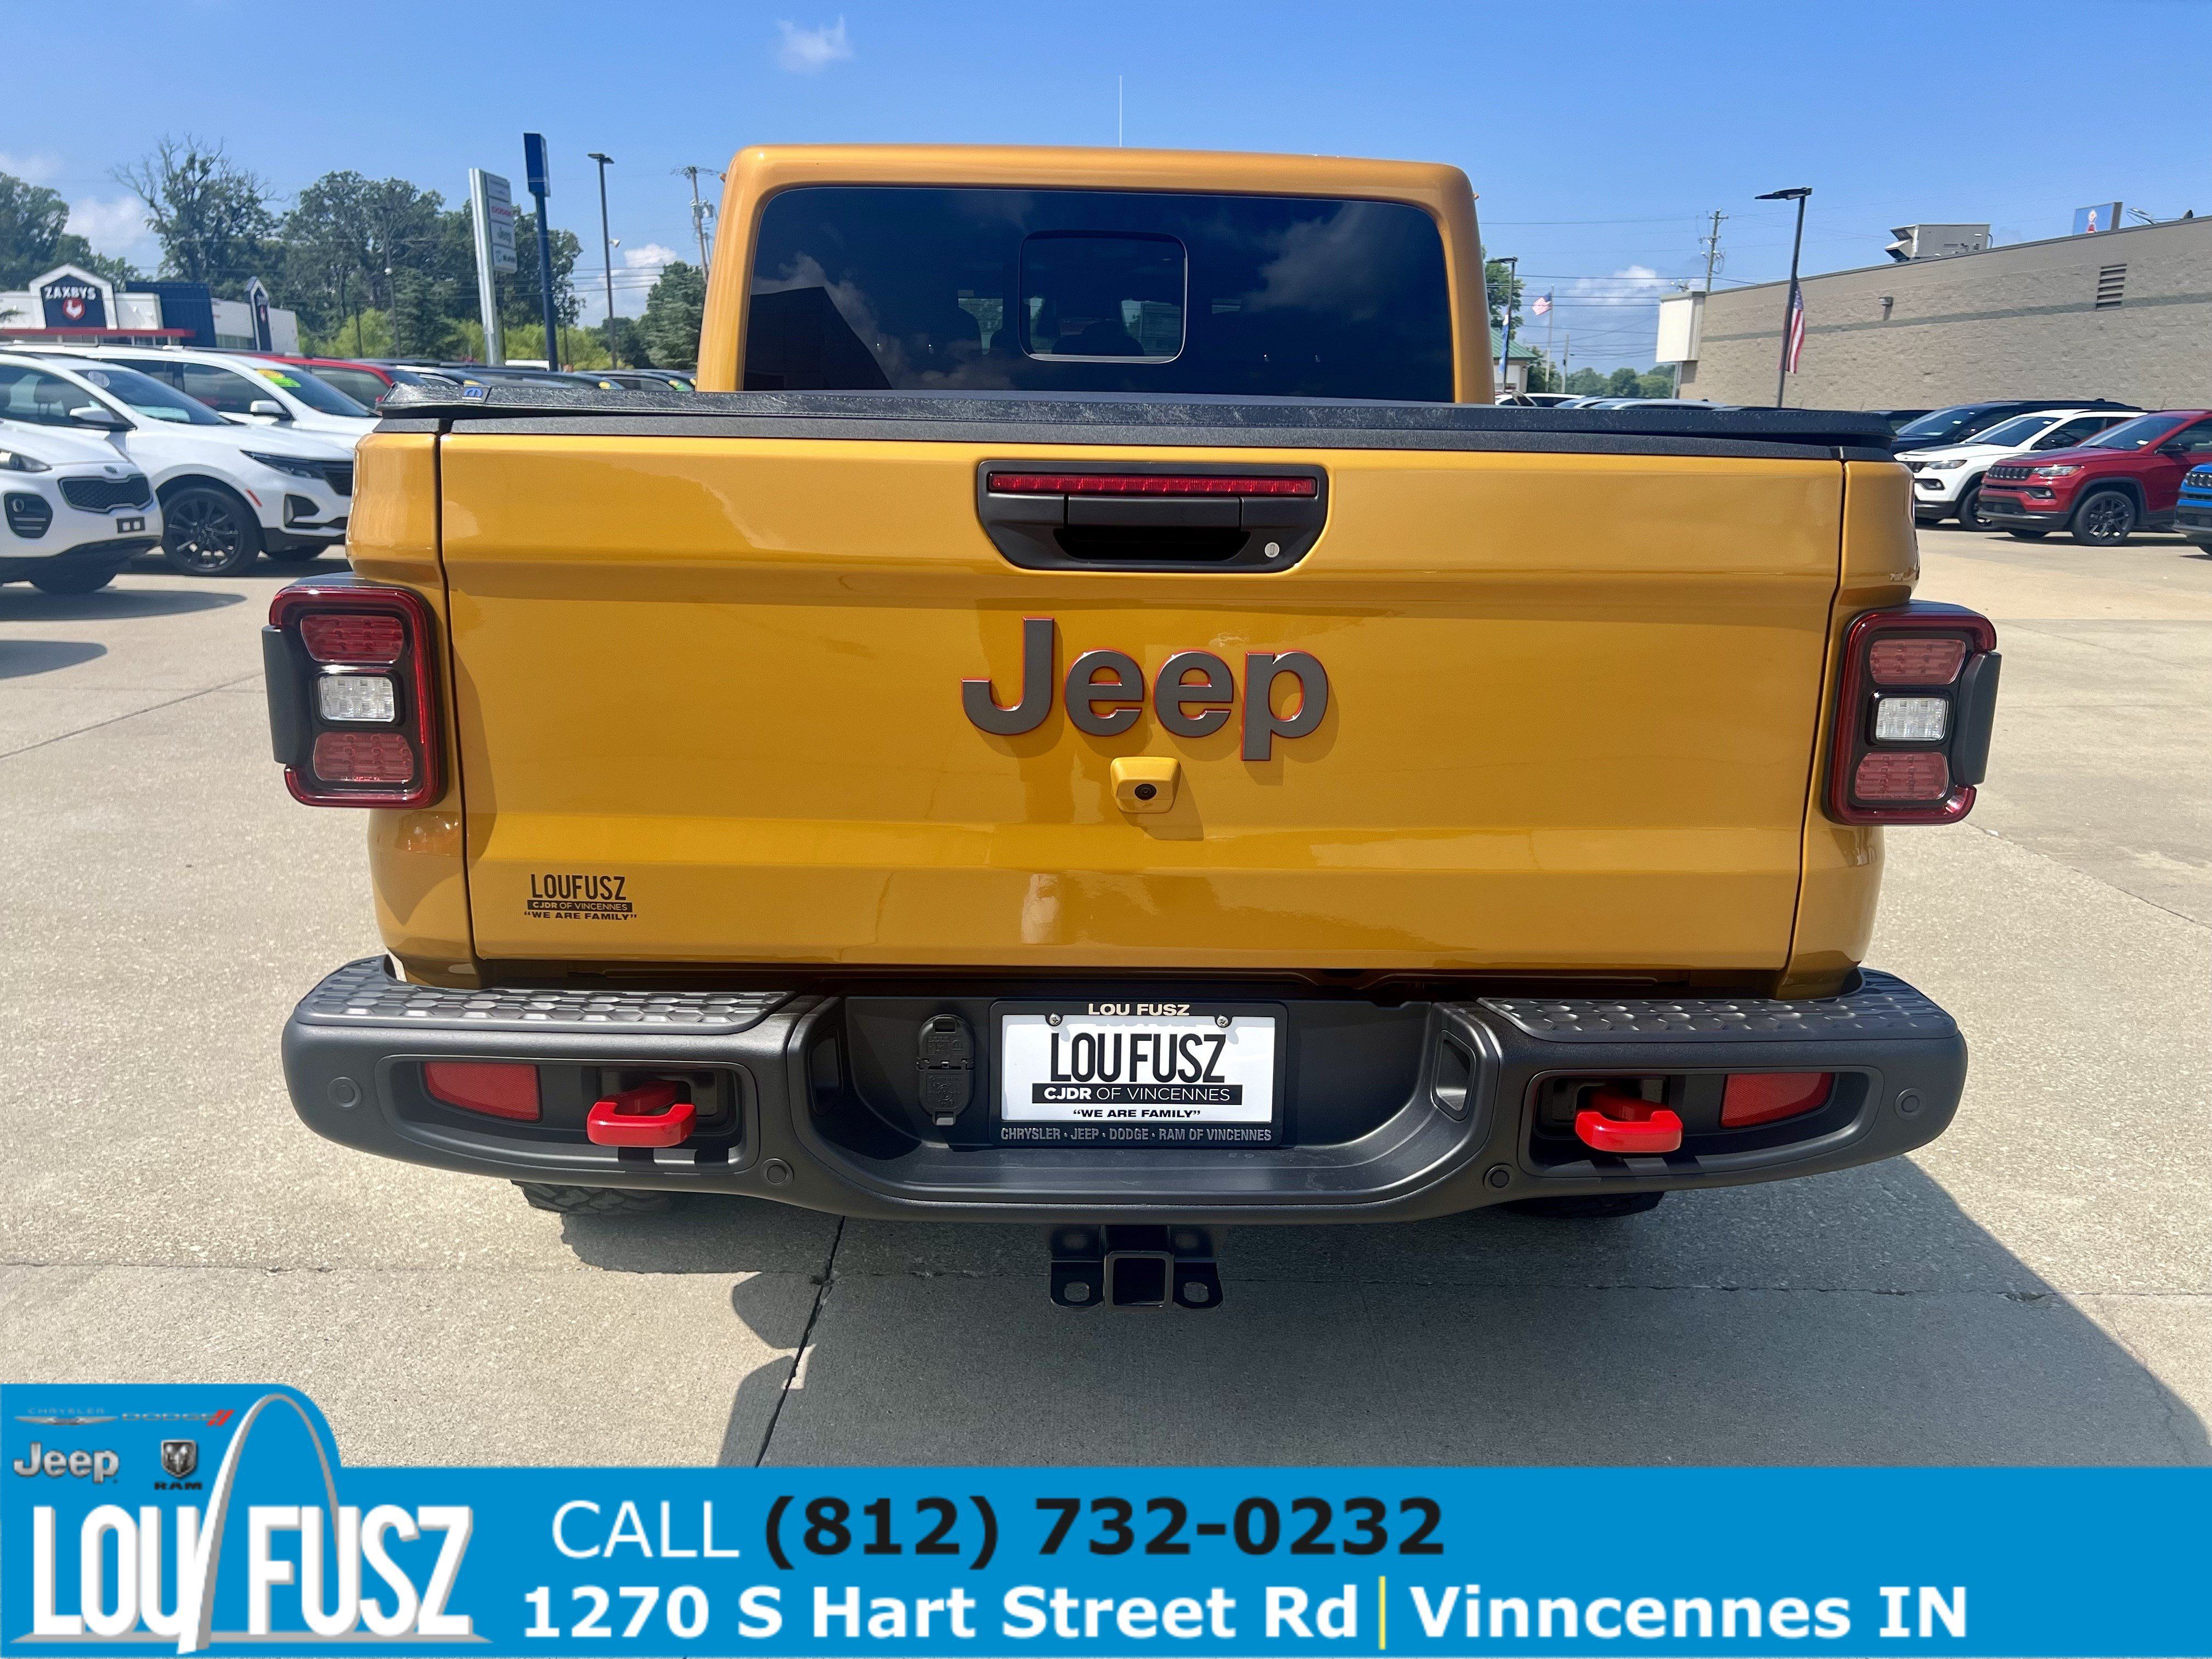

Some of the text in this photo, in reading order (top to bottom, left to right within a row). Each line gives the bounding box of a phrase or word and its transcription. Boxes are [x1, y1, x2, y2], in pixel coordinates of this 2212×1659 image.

[44, 286, 97, 300] ZAXBYS
[961, 616, 1329, 761] Jeep
[574, 902, 628, 911] VINCENNES
[1088, 1003, 1190, 1016] LOU FUSZ
[1043, 1087, 1230, 1102] CJDR OF VINCENNES
[1107, 1109, 1137, 1118] ARE
[1000, 1127, 1272, 1141] CHRYSLER JEEP DODGE RAM OF VINCENNES
